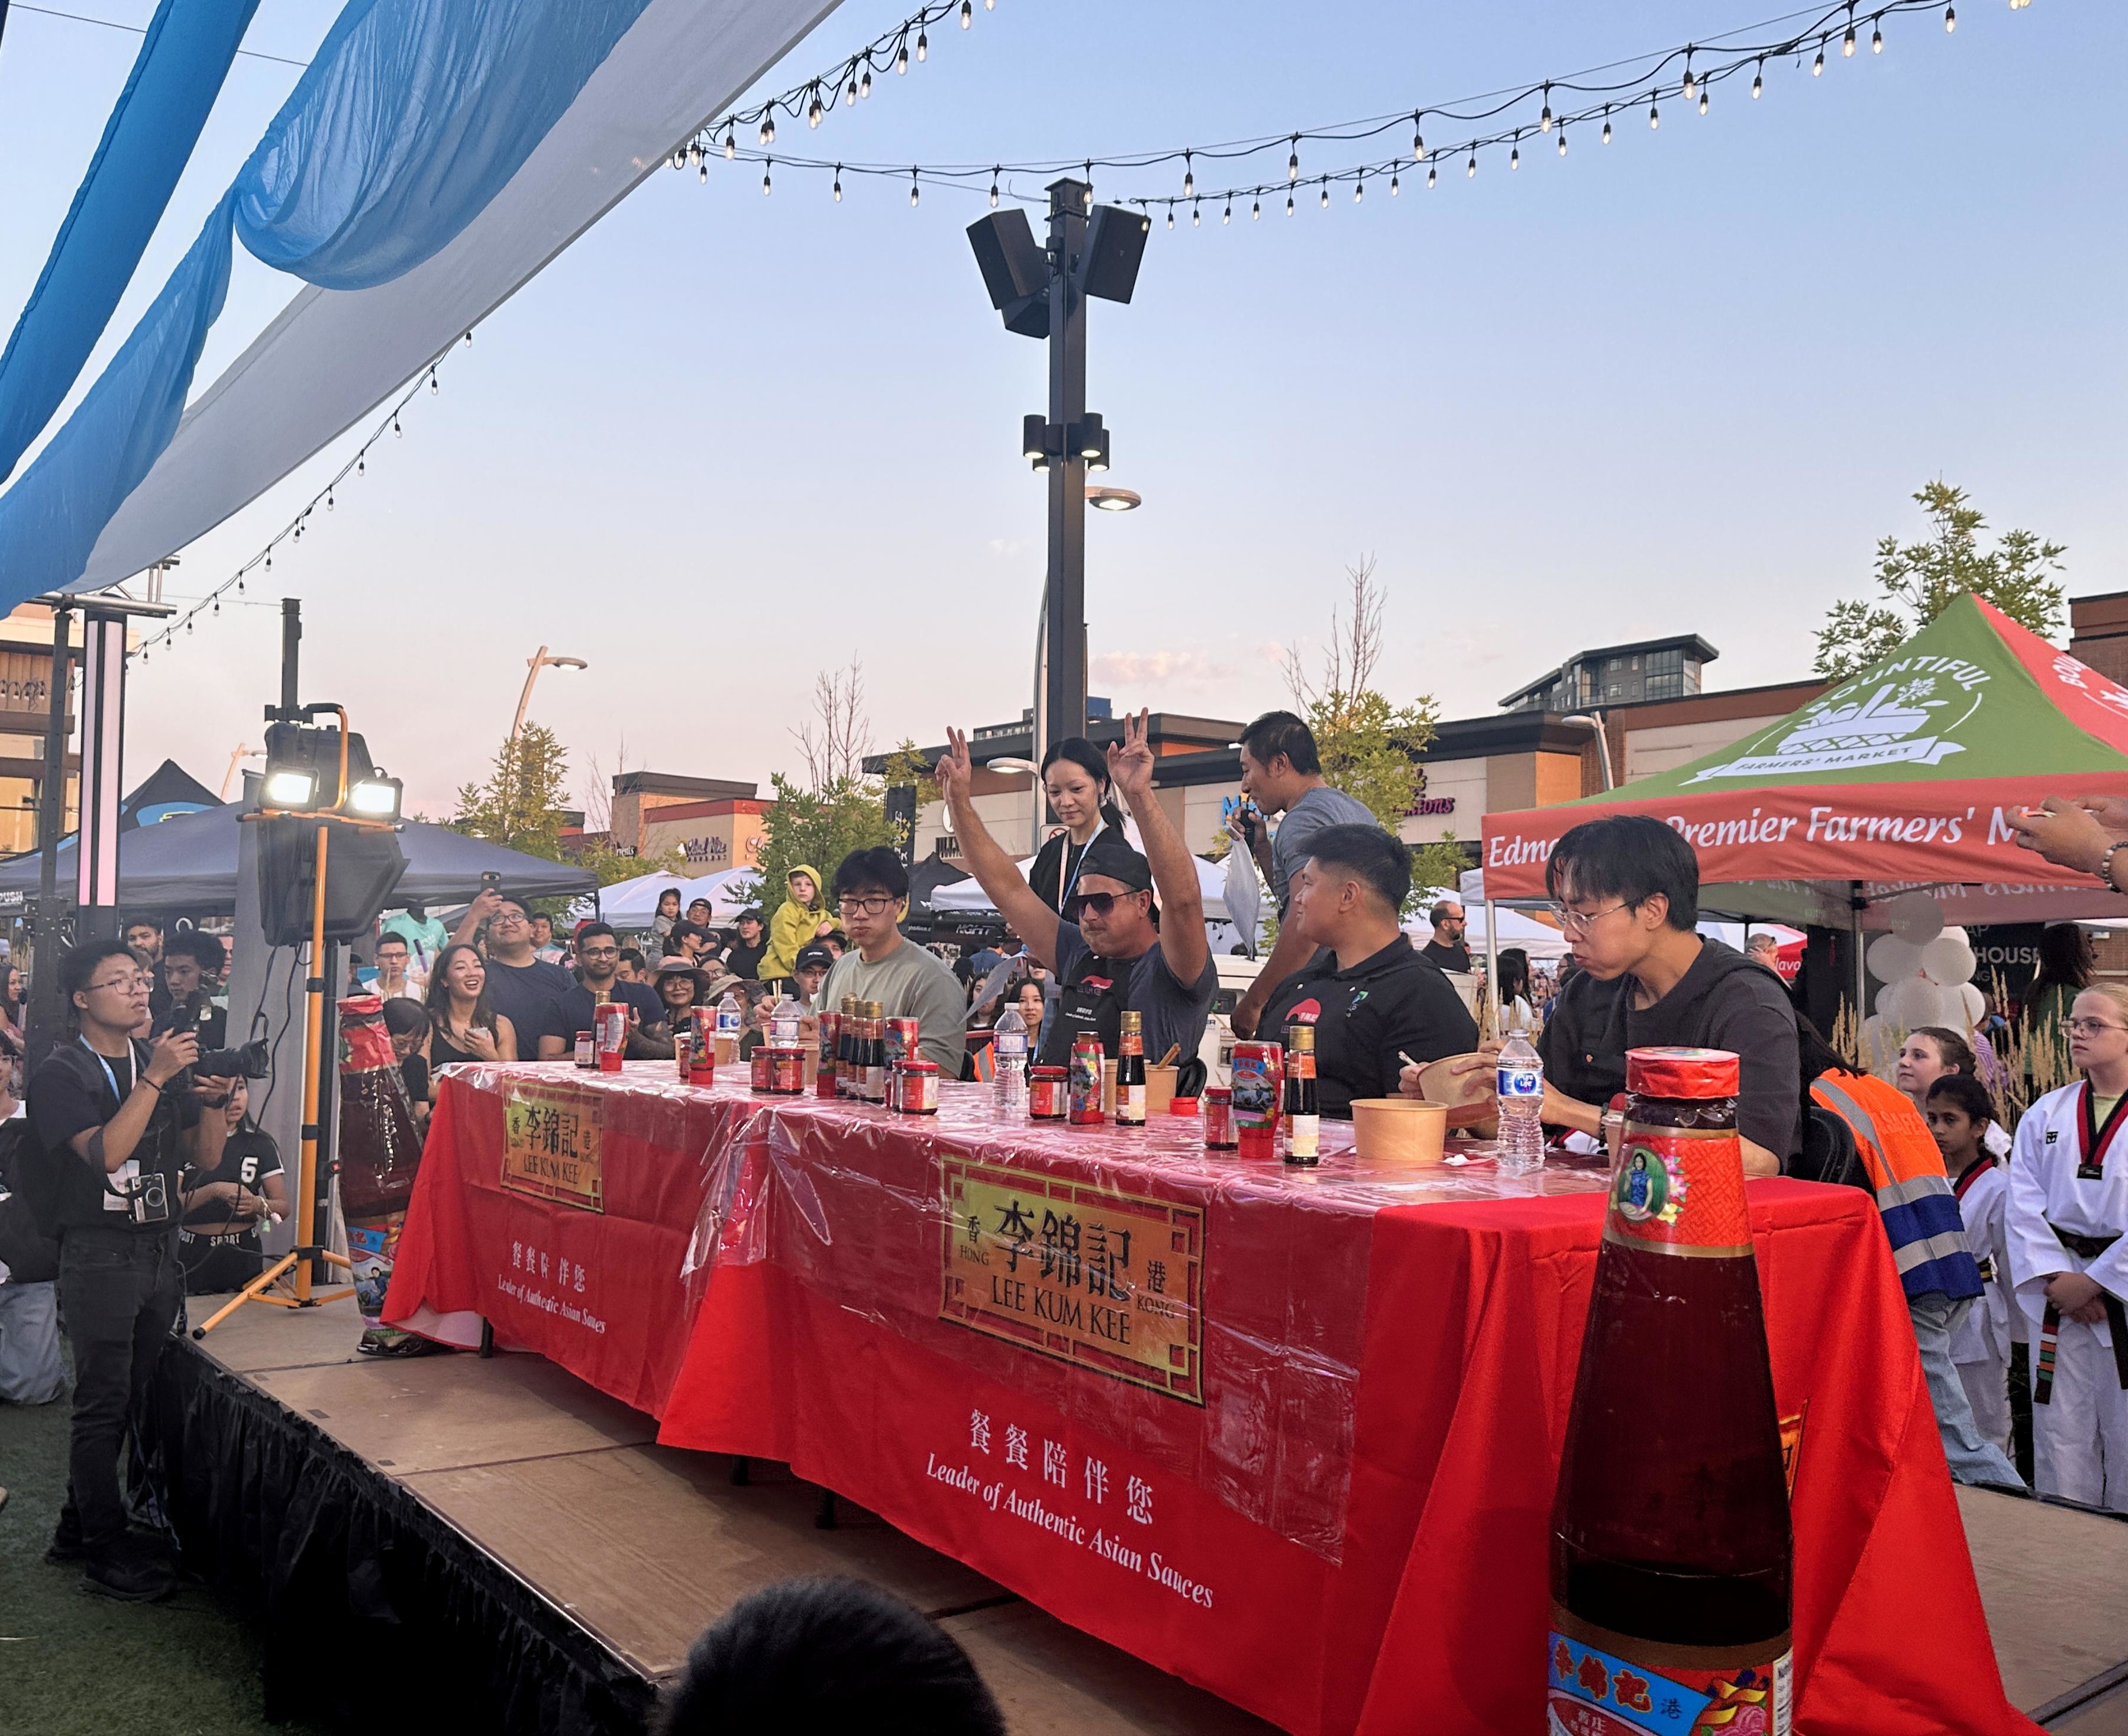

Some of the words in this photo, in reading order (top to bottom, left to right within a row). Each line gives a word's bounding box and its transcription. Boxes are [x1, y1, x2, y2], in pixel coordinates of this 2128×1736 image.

[1805, 655, 1992, 713] BOUNTIFUL
[1735, 757, 1822, 770] FARMERS'
[1825, 746, 1913, 764] MARKET
[1666, 807, 1798, 847] Premier
[1806, 806, 1975, 844] Farmers'
[524, 1106, 579, 1159] 李錦記
[240, 1156, 259, 1183] 5
[524, 1154, 538, 1174] LEE
[562, 1161, 579, 1185] KEE
[967, 1215, 981, 1244] 香
[960, 1244, 990, 1266] HONG
[994, 1199, 1131, 1302] 李錦記
[1147, 1259, 1167, 1294] 港
[560, 1301, 582, 1323] Asian
[992, 1275, 1026, 1312] LEE
[1034, 1286, 1085, 1331] KUM
[1089, 1304, 1131, 1345] KEE
[1136, 1293, 1176, 1319] KONG
[970, 1408, 1154, 1526] 餐餐陪伴您
[926, 1451, 981, 1495] Leader
[983, 1482, 1004, 1511] of
[1003, 1488, 1086, 1546] Authentic
[1088, 1528, 1142, 1573] Asian
[1147, 1551, 1214, 1609] Sauces
